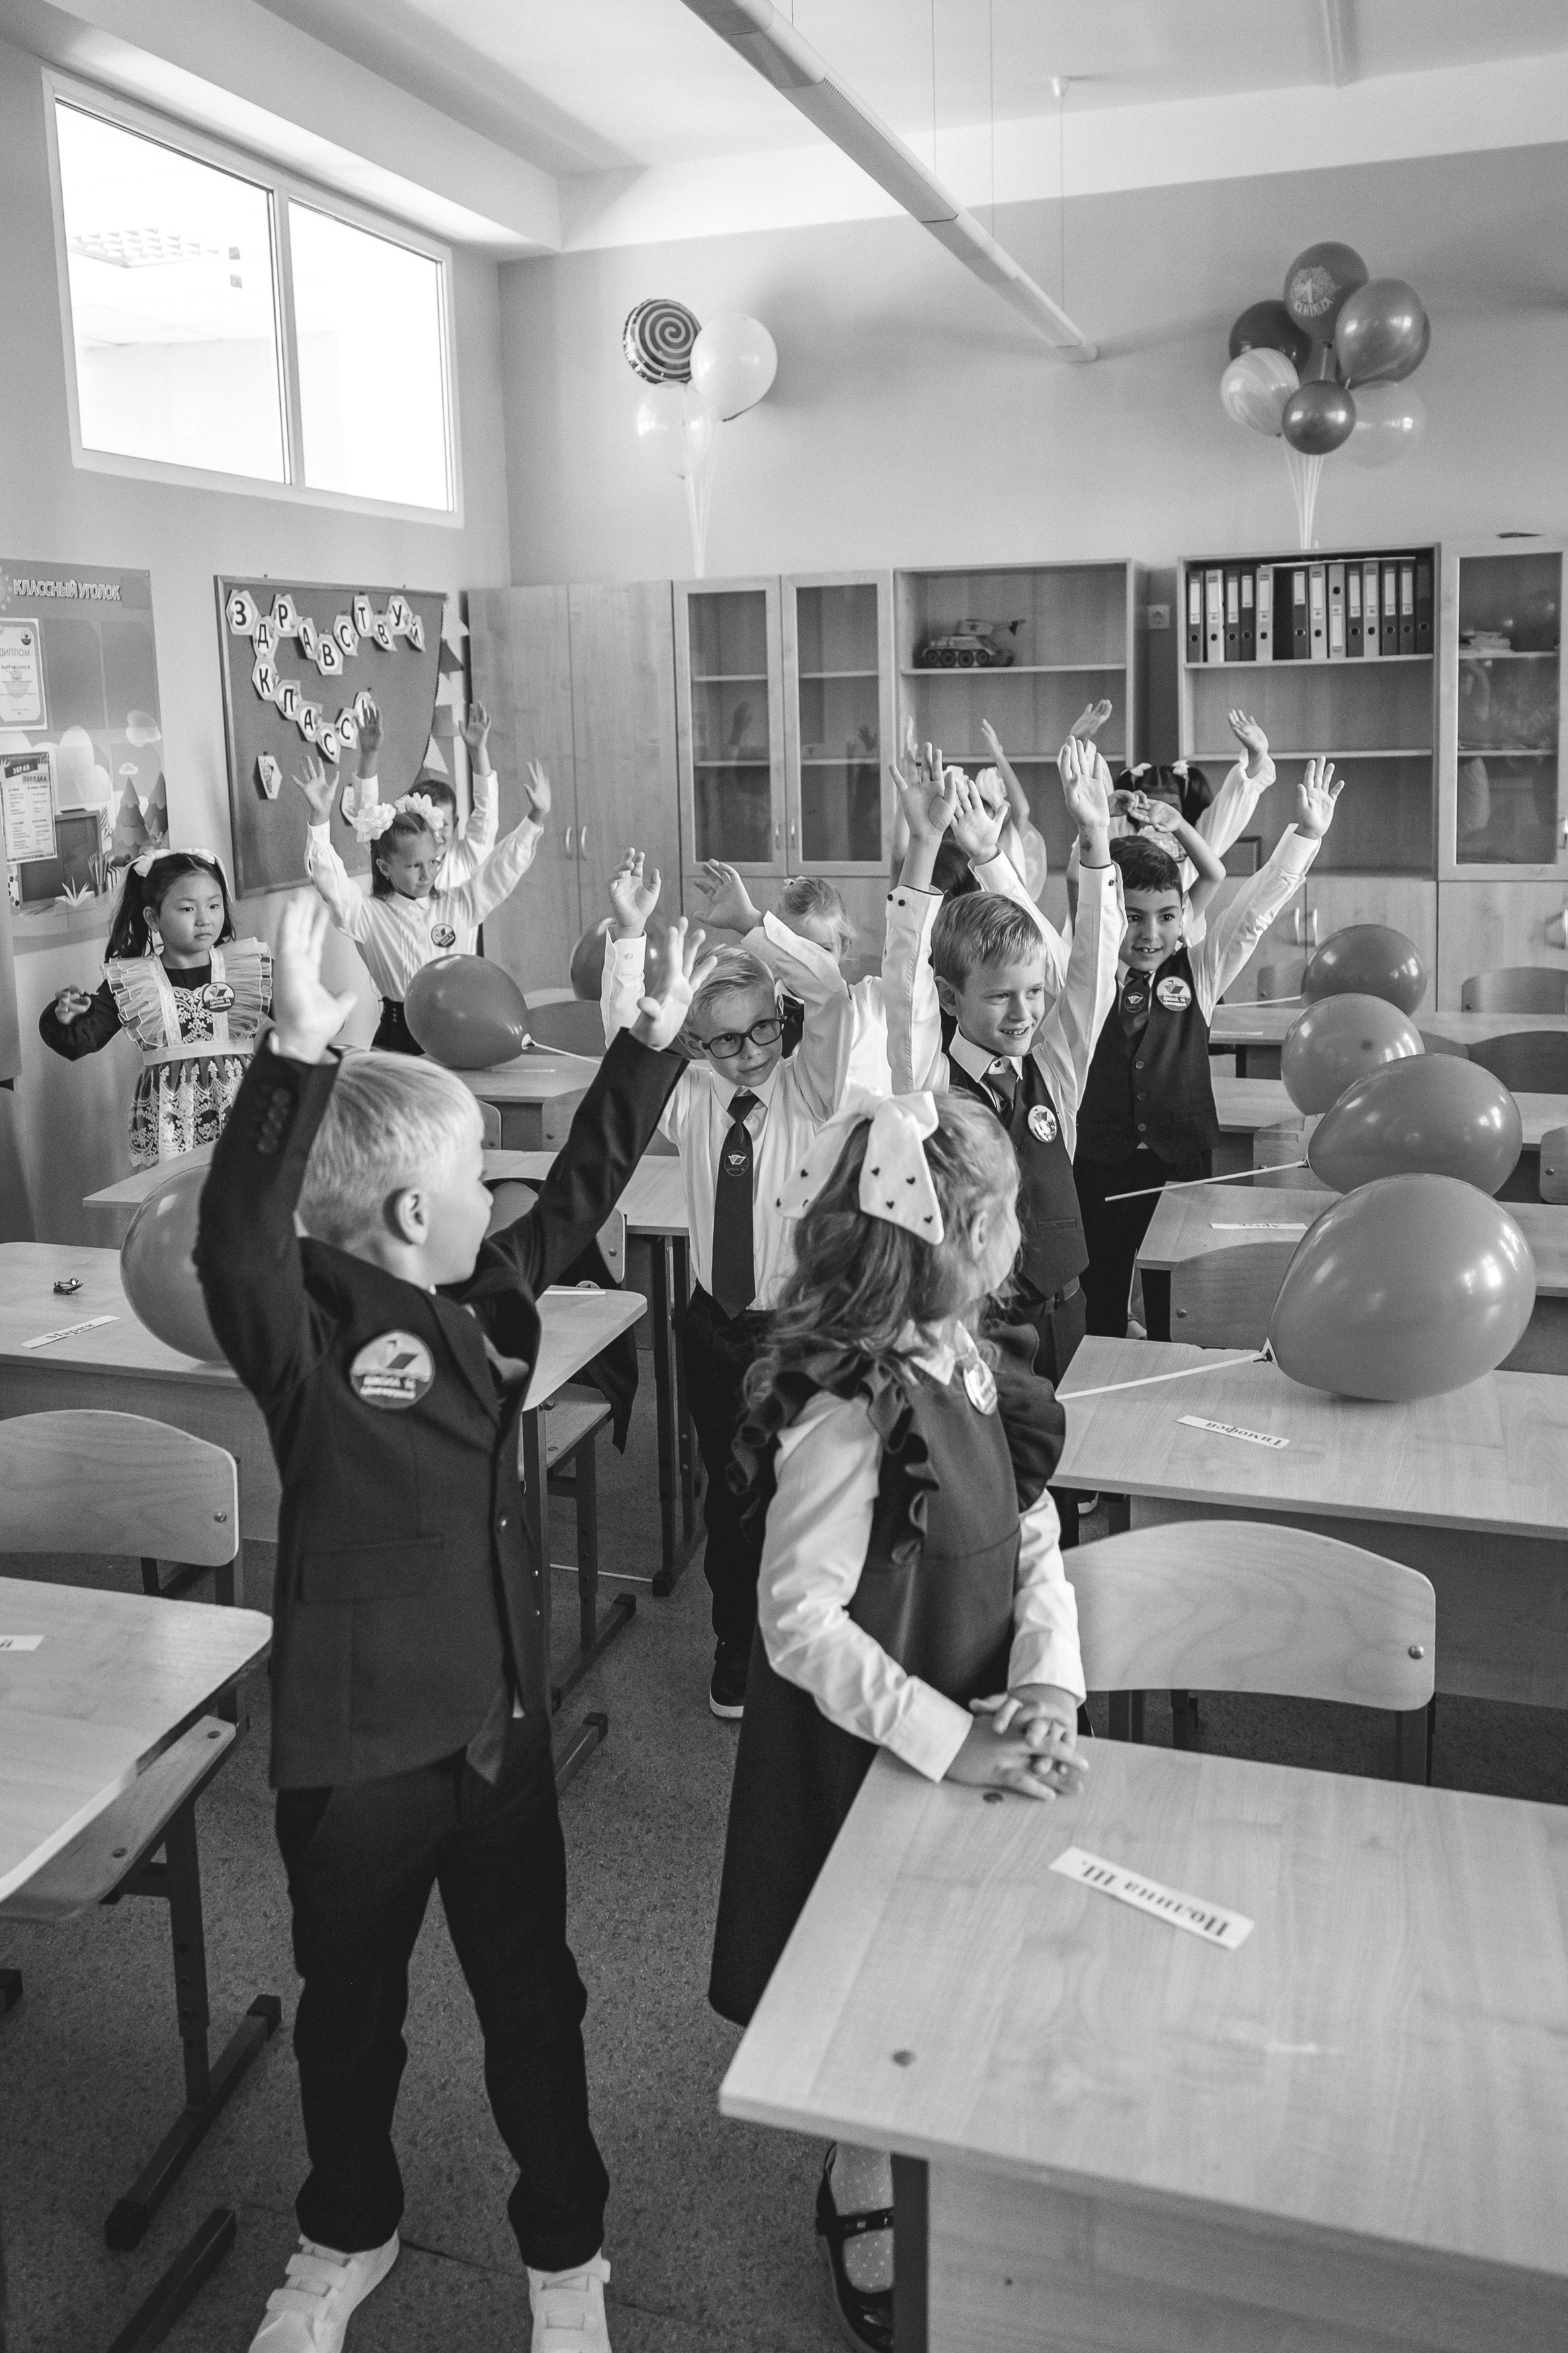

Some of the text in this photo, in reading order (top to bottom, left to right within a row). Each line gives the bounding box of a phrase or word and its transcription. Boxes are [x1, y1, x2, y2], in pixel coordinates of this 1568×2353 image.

[1303, 278, 1313, 304] 1
[13, 578, 122, 600] КЛАССНЫЙ УГОЛОК
[46, 1323, 94, 1339] Мария
[1206, 1422, 1282, 1446] Тимофей
[1124, 1881, 1229, 1936] Полина
